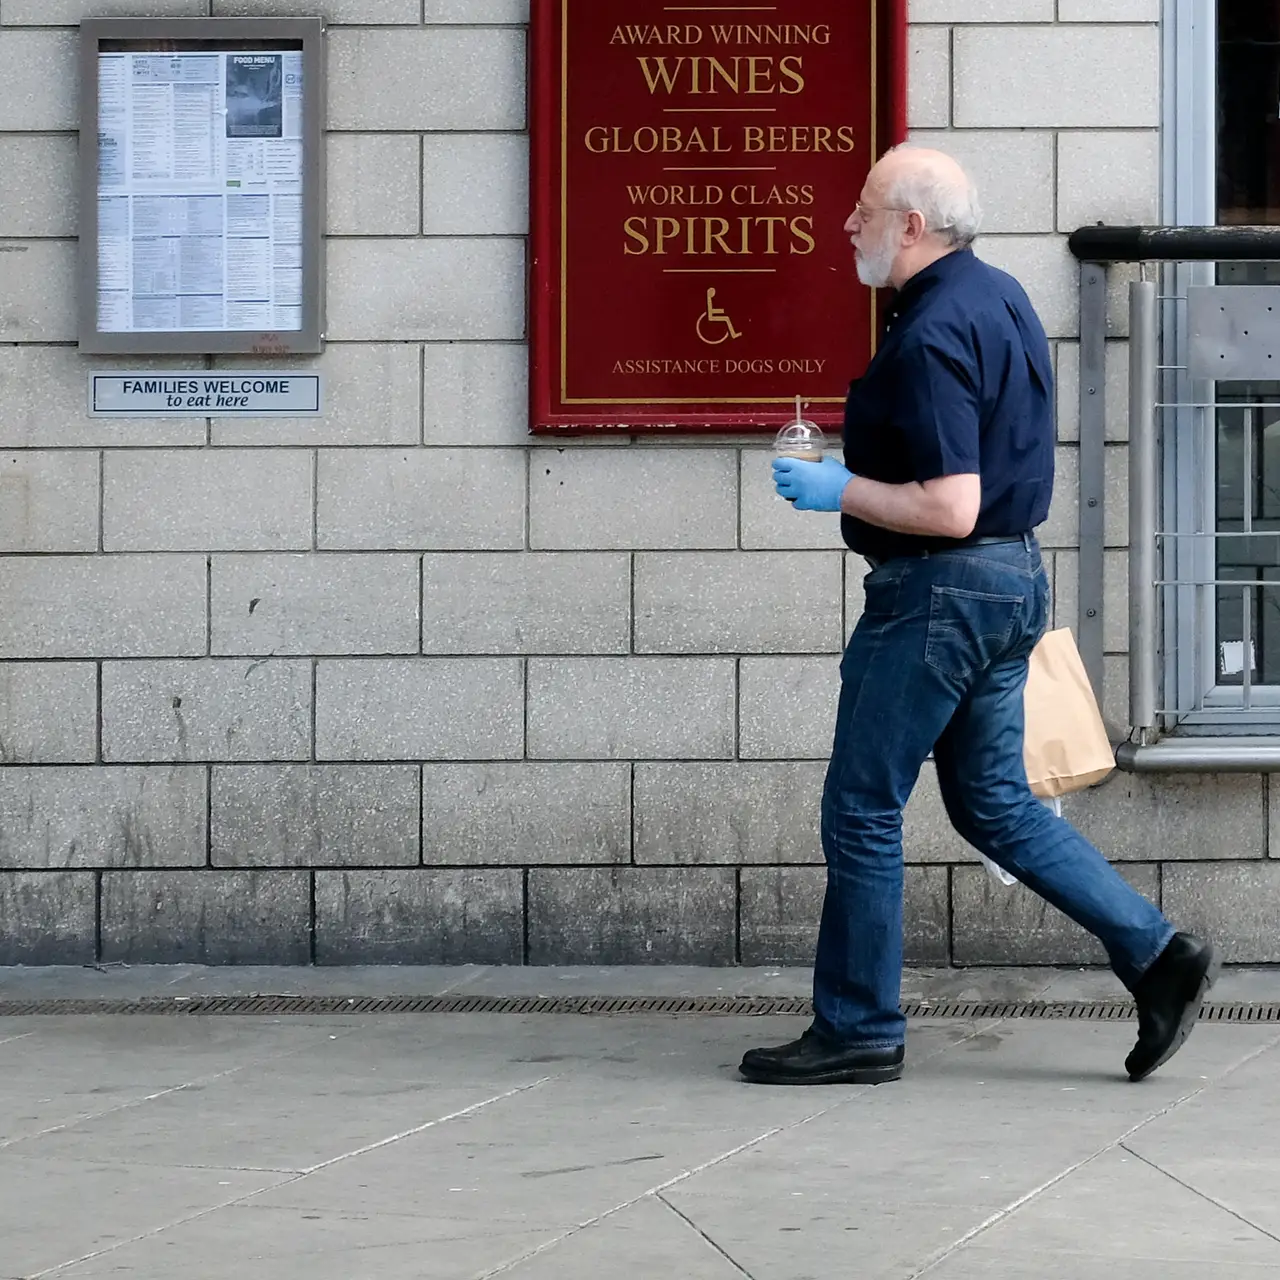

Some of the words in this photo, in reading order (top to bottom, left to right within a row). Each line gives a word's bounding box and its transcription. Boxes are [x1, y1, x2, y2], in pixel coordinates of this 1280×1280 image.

[610, 25, 702, 44] AWARD
[711, 25, 829, 44] WINNING
[233, 56, 253, 64] FOOD
[253, 56, 276, 64] MENU
[637, 56, 804, 94] WINES
[585, 127, 731, 152] GLOBAL
[744, 126, 854, 152] BEERS
[627, 186, 722, 205] WORLD
[731, 185, 813, 204] CLASS
[624, 216, 814, 254] SPIRITS
[613, 360, 719, 373] ASSISTANCE
[726, 360, 773, 372] DOGS
[779, 360, 825, 373] ONLY
[124, 381, 198, 393] FAMILIES
[204, 381, 289, 393] WELCOME
[167, 395, 182, 406] to
[187, 395, 211, 406] eat
[216, 395, 248, 406] here
